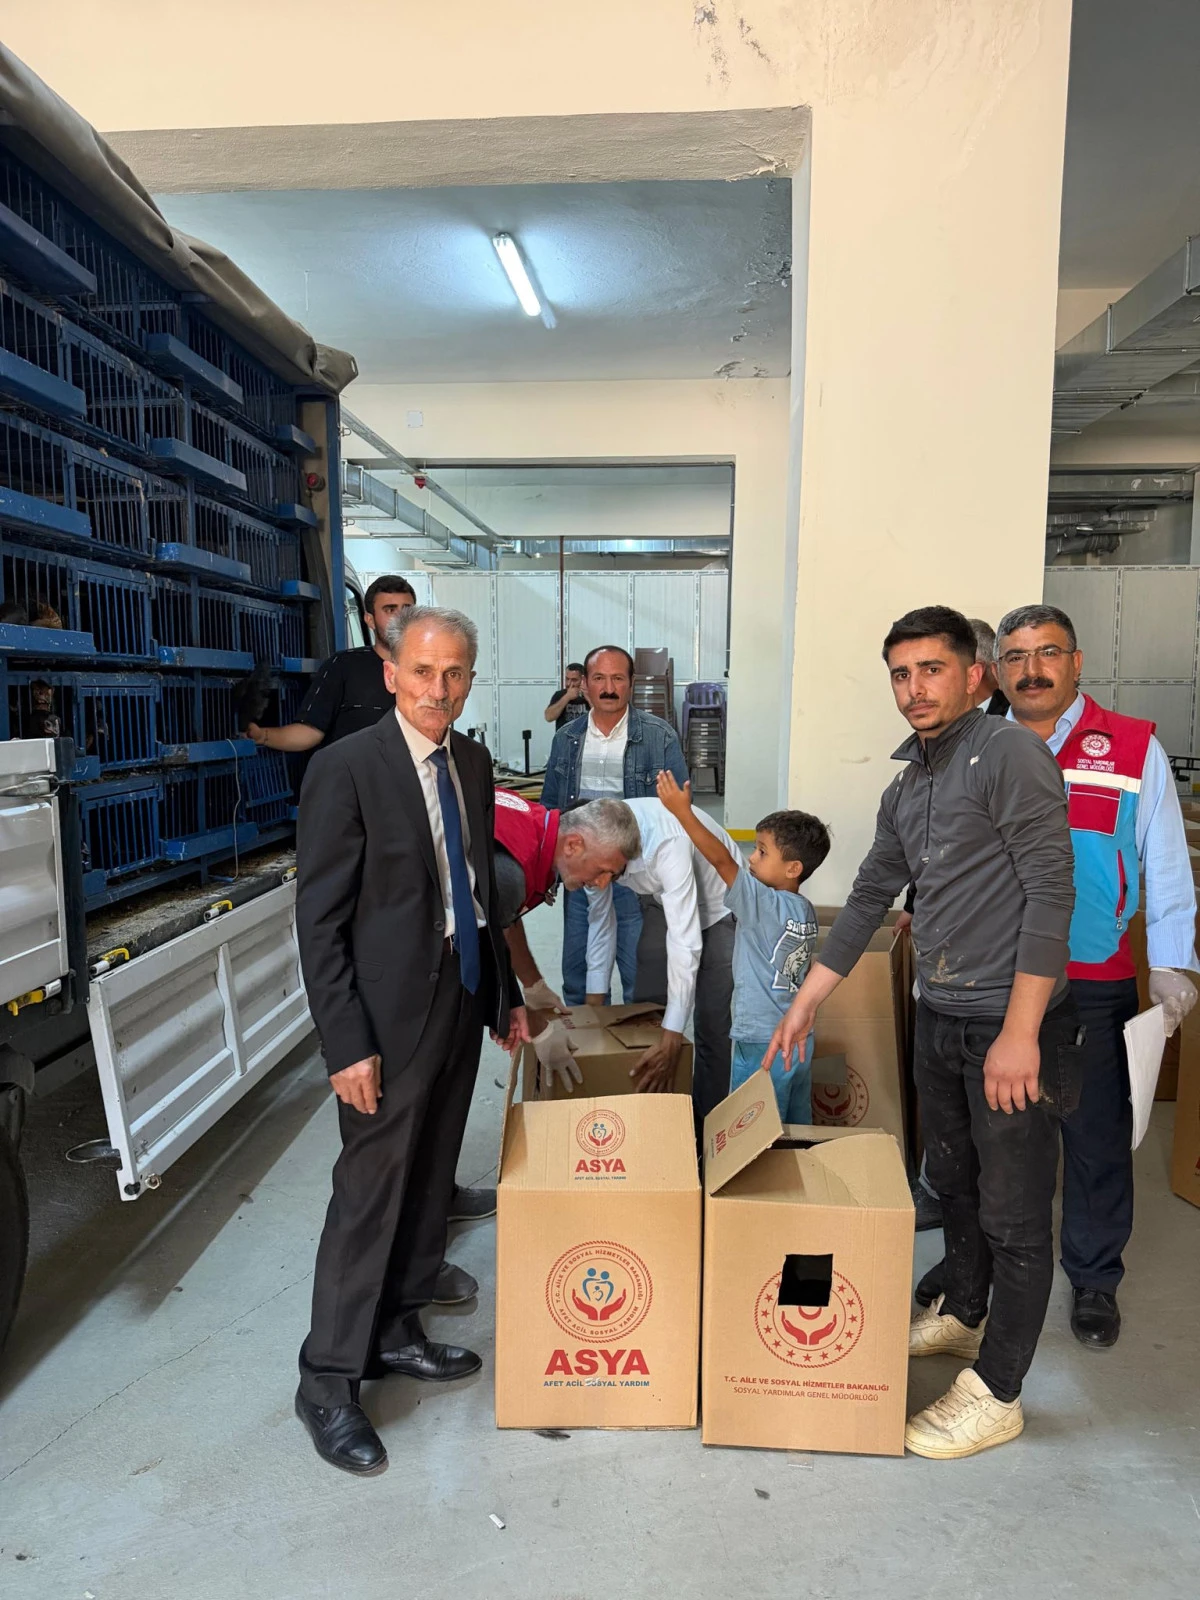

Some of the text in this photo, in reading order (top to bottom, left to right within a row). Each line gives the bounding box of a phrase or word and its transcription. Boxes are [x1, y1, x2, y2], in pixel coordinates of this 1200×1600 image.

[575, 1159, 626, 1173] ASYA
[556, 1274, 564, 1289] AİLE
[562, 1264, 570, 1273] VE
[569, 1250, 593, 1265] SOSYAL
[595, 1249, 631, 1266] HİZMETLER
[559, 1306, 639, 1336] AFET ACİL SOSYAL YARDIM
[544, 1349, 651, 1376] ASYA
[566, 1379, 584, 1387] ACİL
[724, 1375, 738, 1383] T.C.
[740, 1376, 757, 1385] AİLE
[770, 1378, 801, 1387] SOSYAL
[802, 1379, 845, 1390] HİZMETLER
[846, 1383, 890, 1392] BAKANLIĞI
[733, 1386, 879, 1401] SOSYAL YARDIMLAR GENEL MÜDÜRLÜĞÜ
